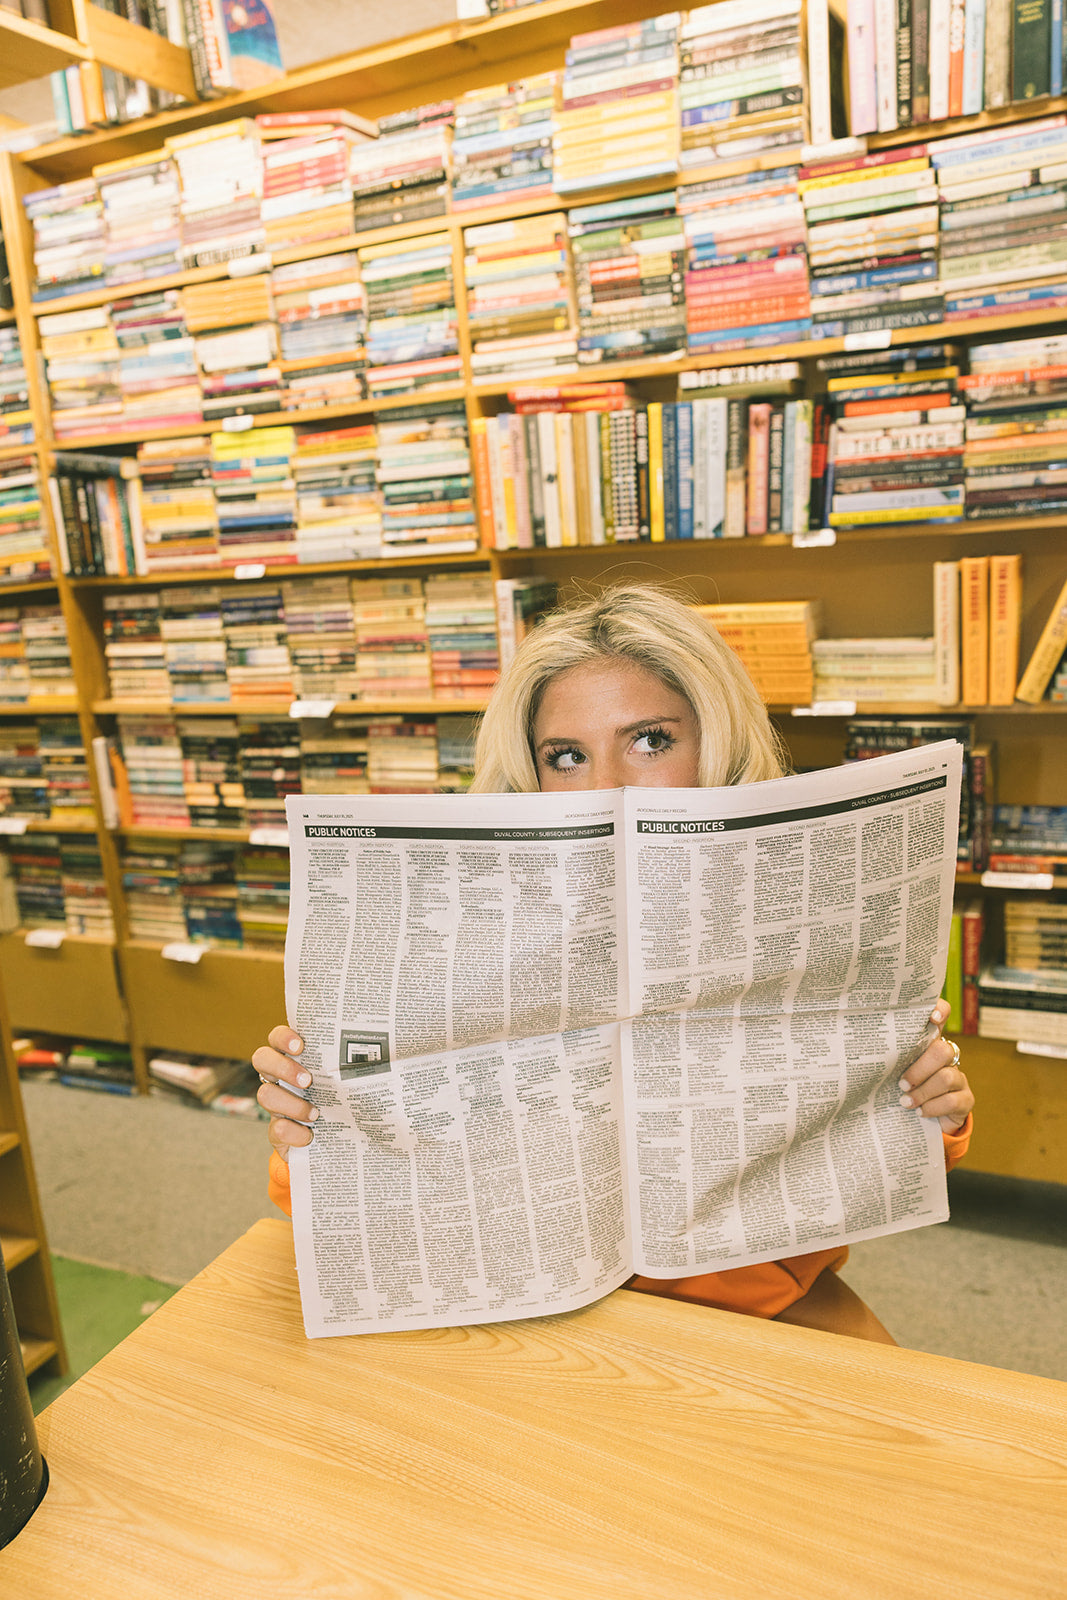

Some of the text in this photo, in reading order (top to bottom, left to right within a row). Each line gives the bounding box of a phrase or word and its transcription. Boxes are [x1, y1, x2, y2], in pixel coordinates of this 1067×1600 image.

[851, 799, 867, 807] DUVAL
[867, 795, 887, 804] COUNTY
[890, 787, 919, 799] SUBSEQUENT
[919, 779, 944, 790] INSERTIONS
[308, 827, 377, 837] PUBLIC NOTICES
[538, 830, 577, 838] SUBSEQUENT
[577, 826, 611, 836] INSERTIONS
[641, 821, 725, 833] PUBLIC NOTICES
